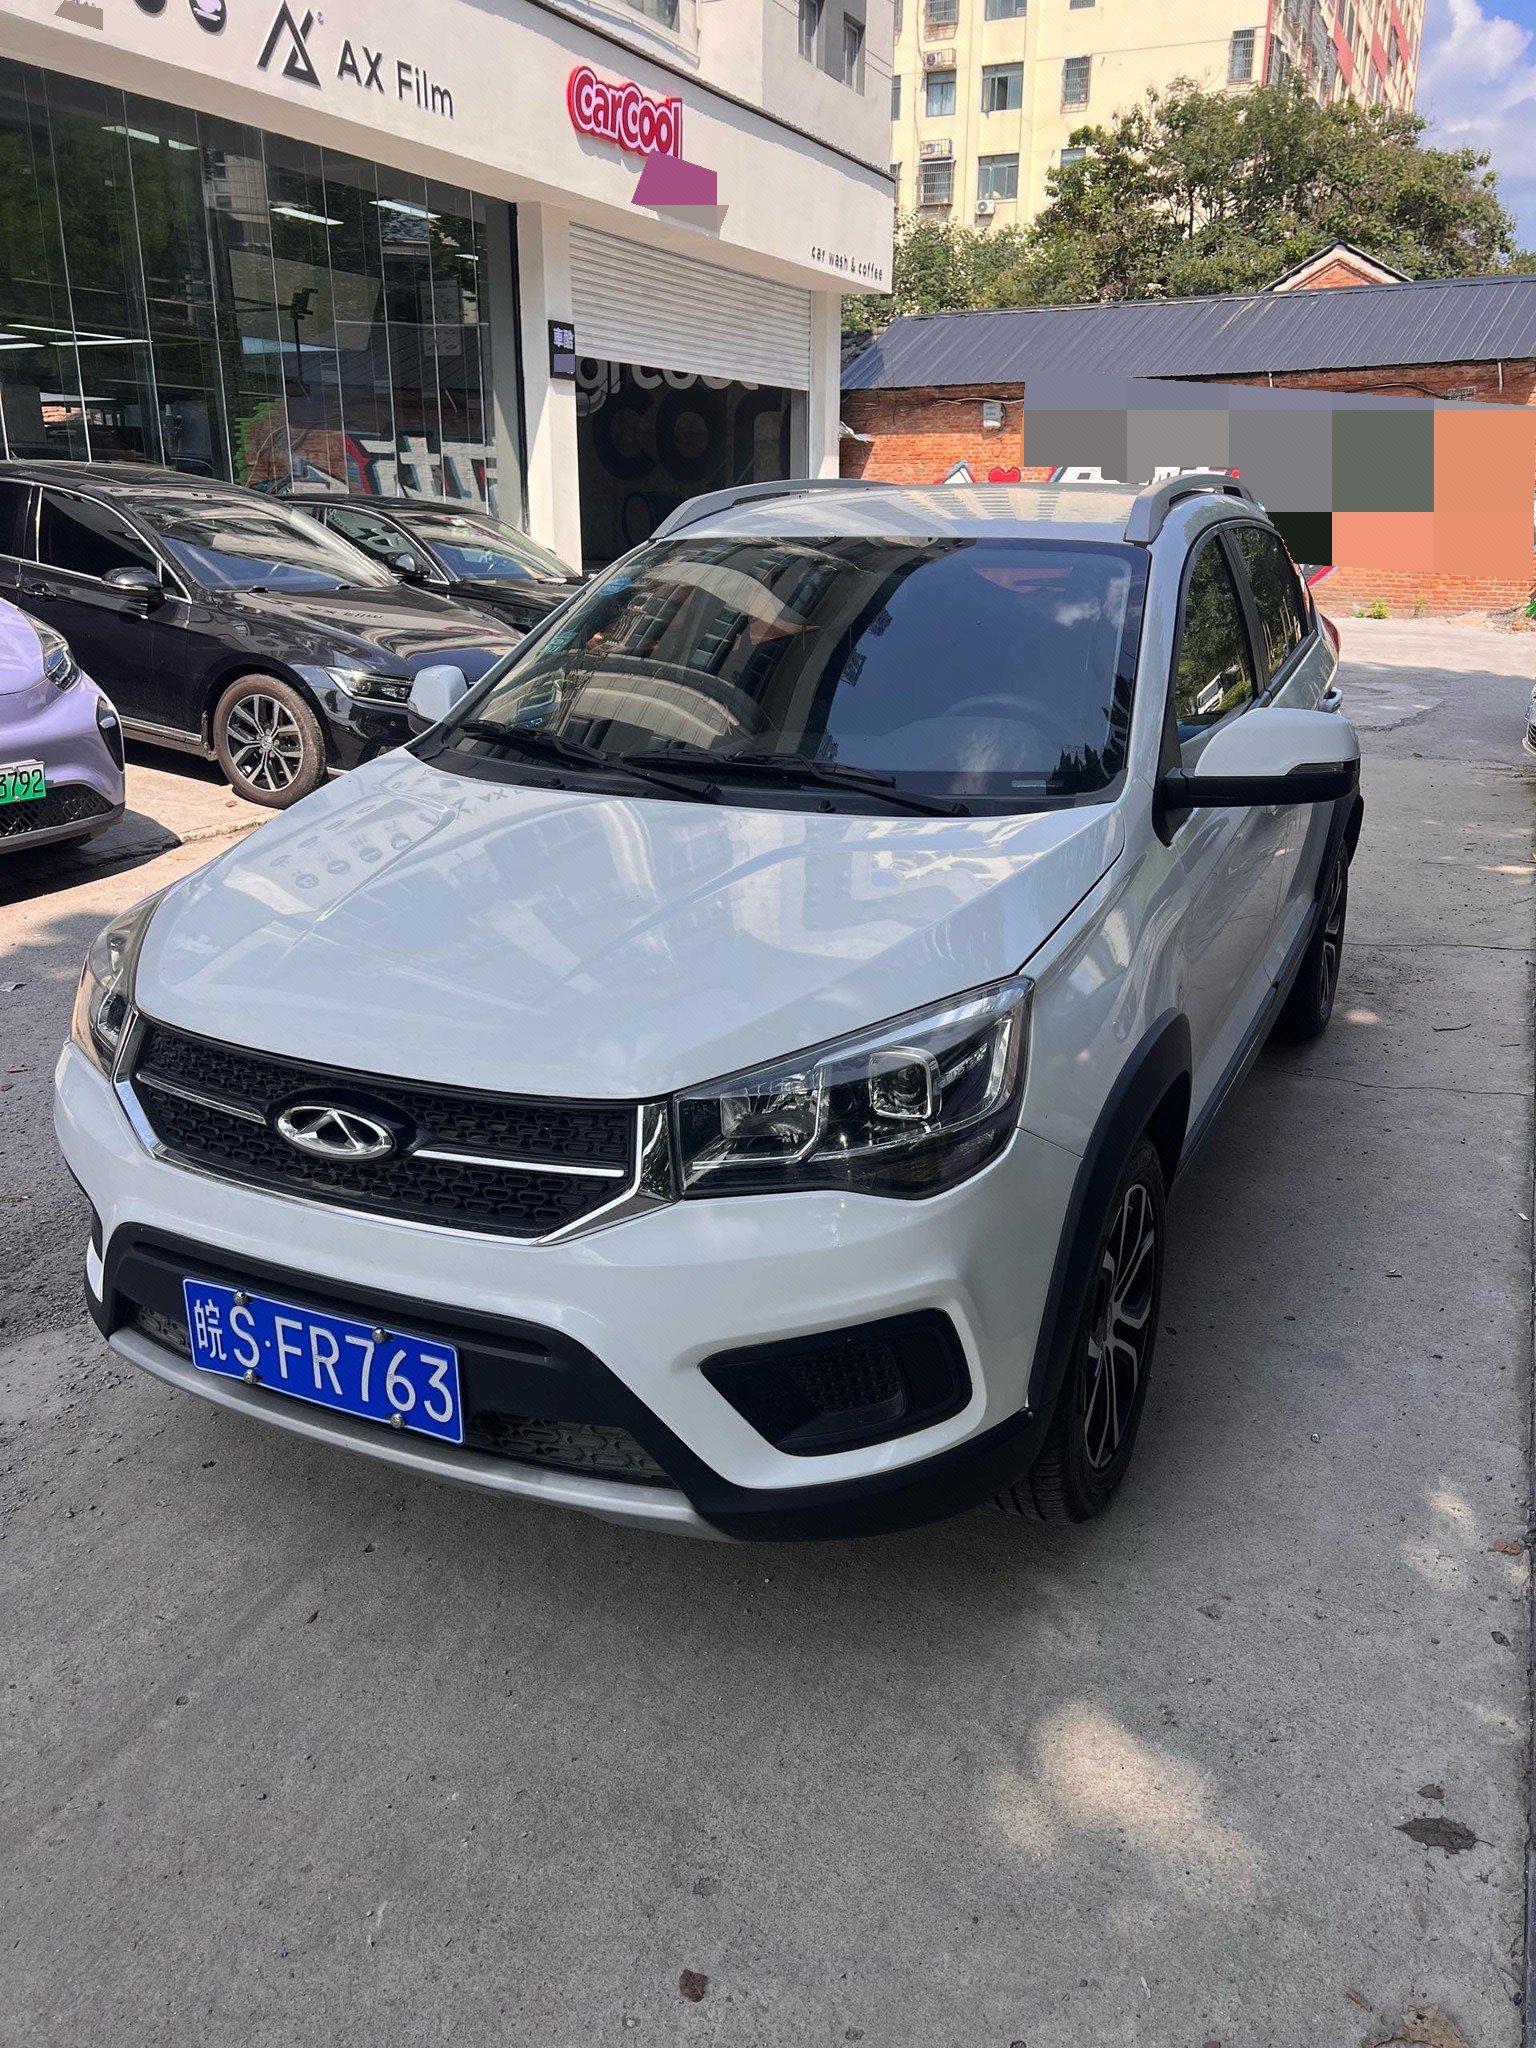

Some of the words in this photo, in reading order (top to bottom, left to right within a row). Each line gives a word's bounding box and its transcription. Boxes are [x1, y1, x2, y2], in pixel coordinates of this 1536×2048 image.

[337, 39, 384, 94] AX
[397, 60, 454, 118] Film
[811, 246, 825, 262] car
[828, 252, 848, 270] wash
[858, 261, 882, 281] coffee
